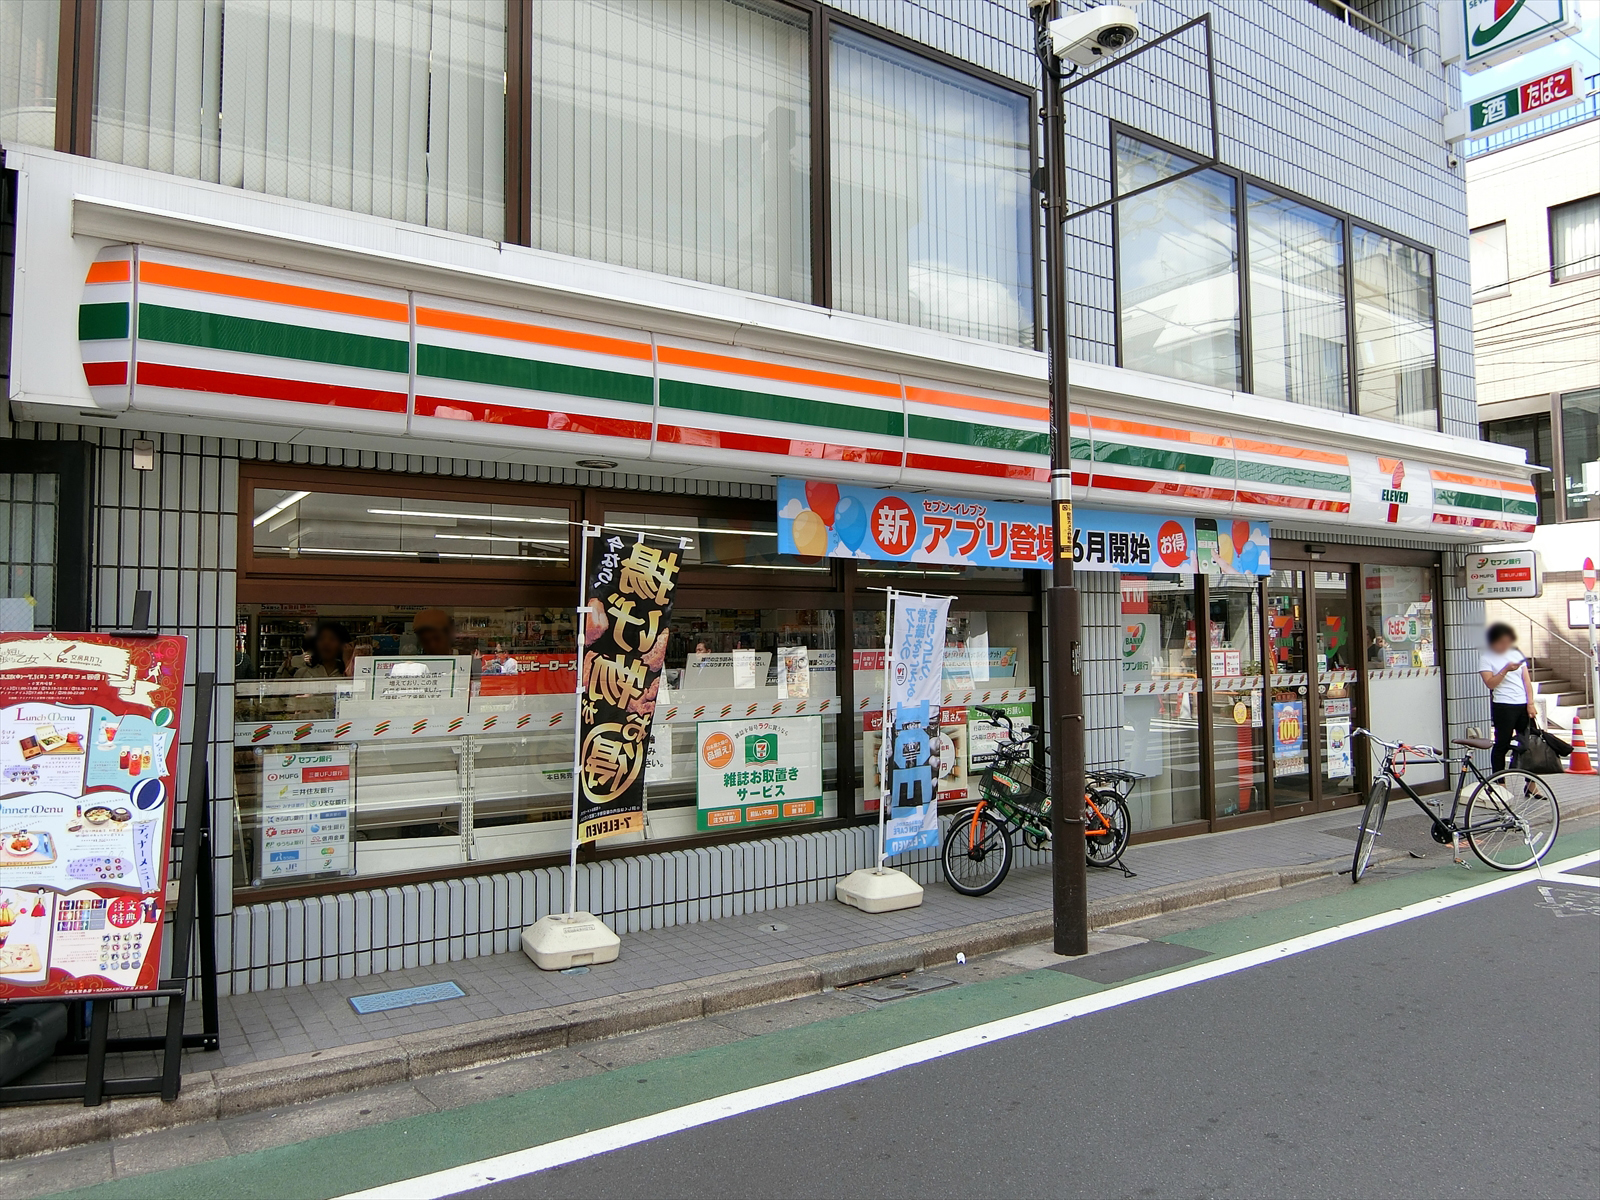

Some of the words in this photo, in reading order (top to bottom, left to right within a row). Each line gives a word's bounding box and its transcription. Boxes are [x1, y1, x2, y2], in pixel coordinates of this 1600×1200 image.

[1482, 95, 1507, 126] 酒
[1527, 74, 1567, 110] たばこ
[1381, 488, 1409, 504] ELEVEn
[878, 505, 910, 546] 新
[1073, 529, 1151, 564] 6月開始
[1160, 532, 1185, 554] お得
[1490, 558, 1521, 566] セブン銀行
[1388, 620, 1406, 636] たばこ
[1409, 620, 1417, 635] 酒
[14, 707, 46, 721] Lunch
[47, 712, 76, 721] Menu
[298, 755, 332, 764] セブン銀行
[723, 767, 799, 787] 雑誌お取置き
[292, 787, 334, 796] 三井住友銀行
[737, 785, 786, 801] サービス
[0, 803, 30, 815] inner
[31, 805, 64, 815] Menu
[318, 798, 347, 806] りそな銀行
[113, 900, 138, 912] 注文
[112, 912, 138, 924] 特典
